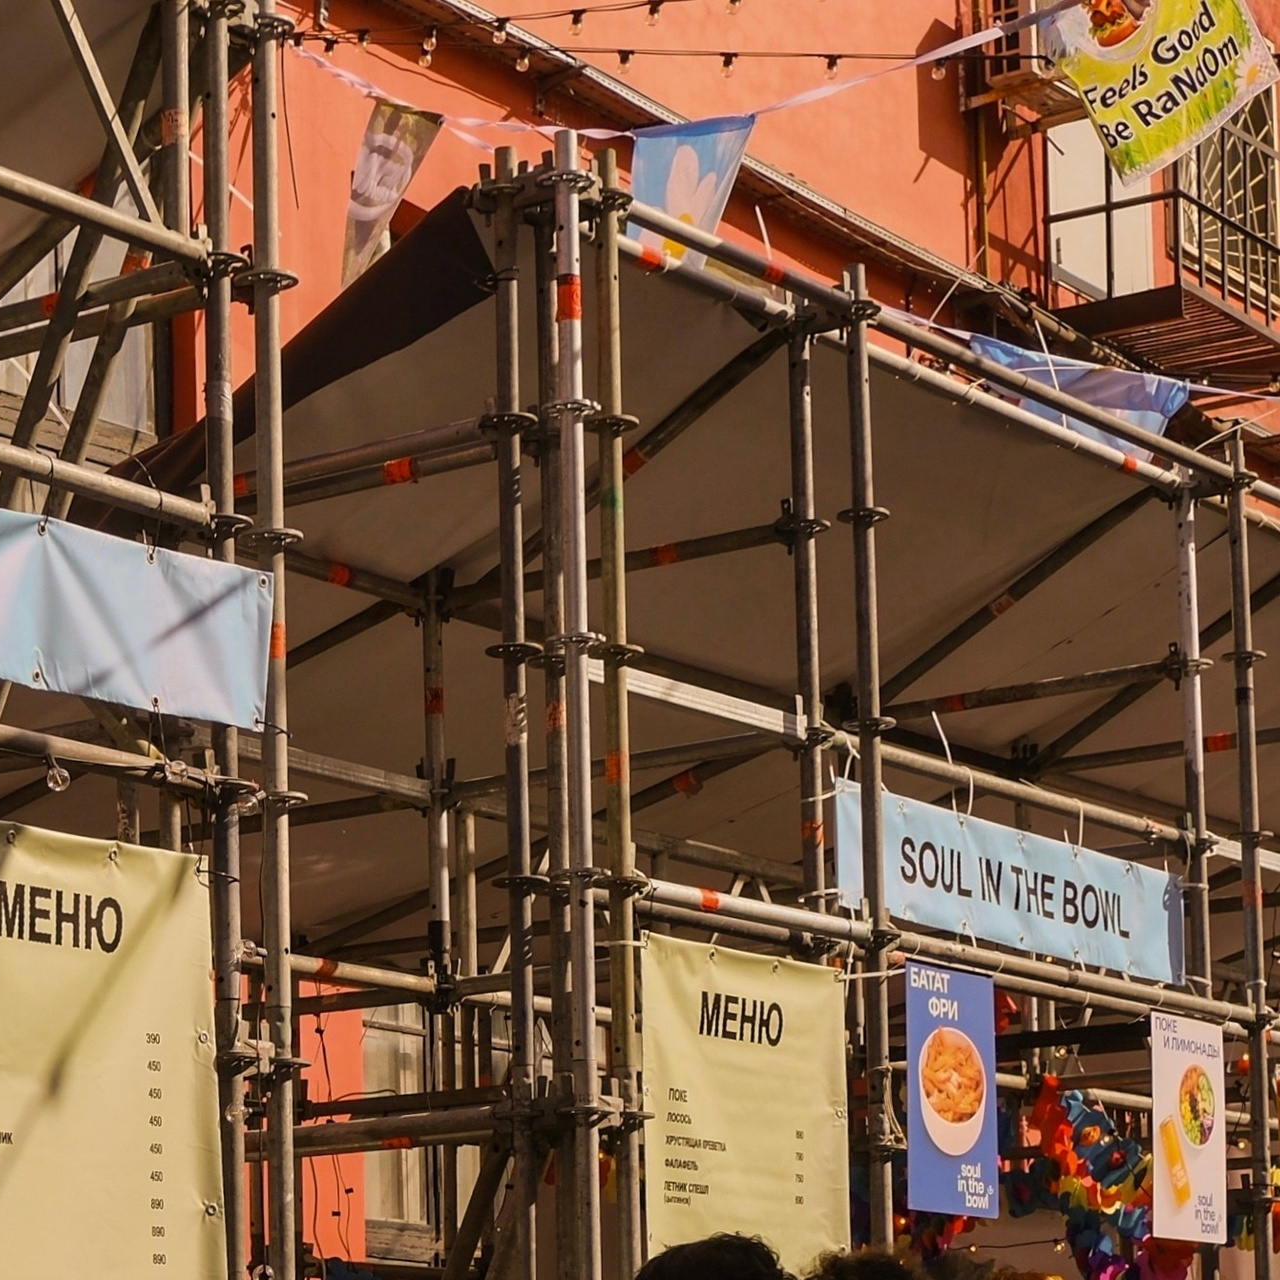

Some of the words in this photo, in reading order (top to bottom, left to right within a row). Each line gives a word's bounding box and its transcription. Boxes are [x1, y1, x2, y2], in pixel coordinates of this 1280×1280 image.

[1083, 62, 1148, 114] Feels
[1152, 0, 1216, 65] Good
[1099, 119, 1134, 149] Be
[1131, 34, 1240, 128] RaNdOm
[900, 836, 972, 899] SOUL
[979, 856, 1002, 905] IN
[1010, 865, 1055, 920] THE
[1063, 880, 1130, 939] BOWL
[910, 966, 950, 994] БАТАТ
[928, 996, 958, 1021] ФРИ
[699, 990, 783, 1047] МЕНЮ
[1155, 1016, 1177, 1033] ПОКЕ
[146, 1033, 160, 1044] 390
[1163, 1035, 1170, 1050] И
[1171, 1037, 1220, 1058] ЛИМОНАДЫ
[147, 1060, 161, 1072] 450
[149, 1088, 162, 1099] 450
[668, 1088, 687, 1102] ПОКЕ
[149, 1116, 162, 1127] 450
[666, 1112, 692, 1124] ЛОСОСЬ
[149, 1143, 162, 1155] 450
[664, 1158, 698, 1171] ФАЛАФЕЛЬ
[961, 1162, 981, 1178] soul
[150, 1171, 163, 1182] 450
[957, 1174, 966, 1192] in
[968, 1178, 985, 1194] the
[151, 1199, 164, 1209] 890
[966, 1191, 989, 1209] bowl
[1198, 1193, 1213, 1207] soul
[1194, 1204, 1202, 1220] in
[1203, 1207, 1216, 1221] the
[152, 1226, 165, 1237] 890
[1201, 1221, 1219, 1235] bowl
[153, 1254, 166, 1265] 890
